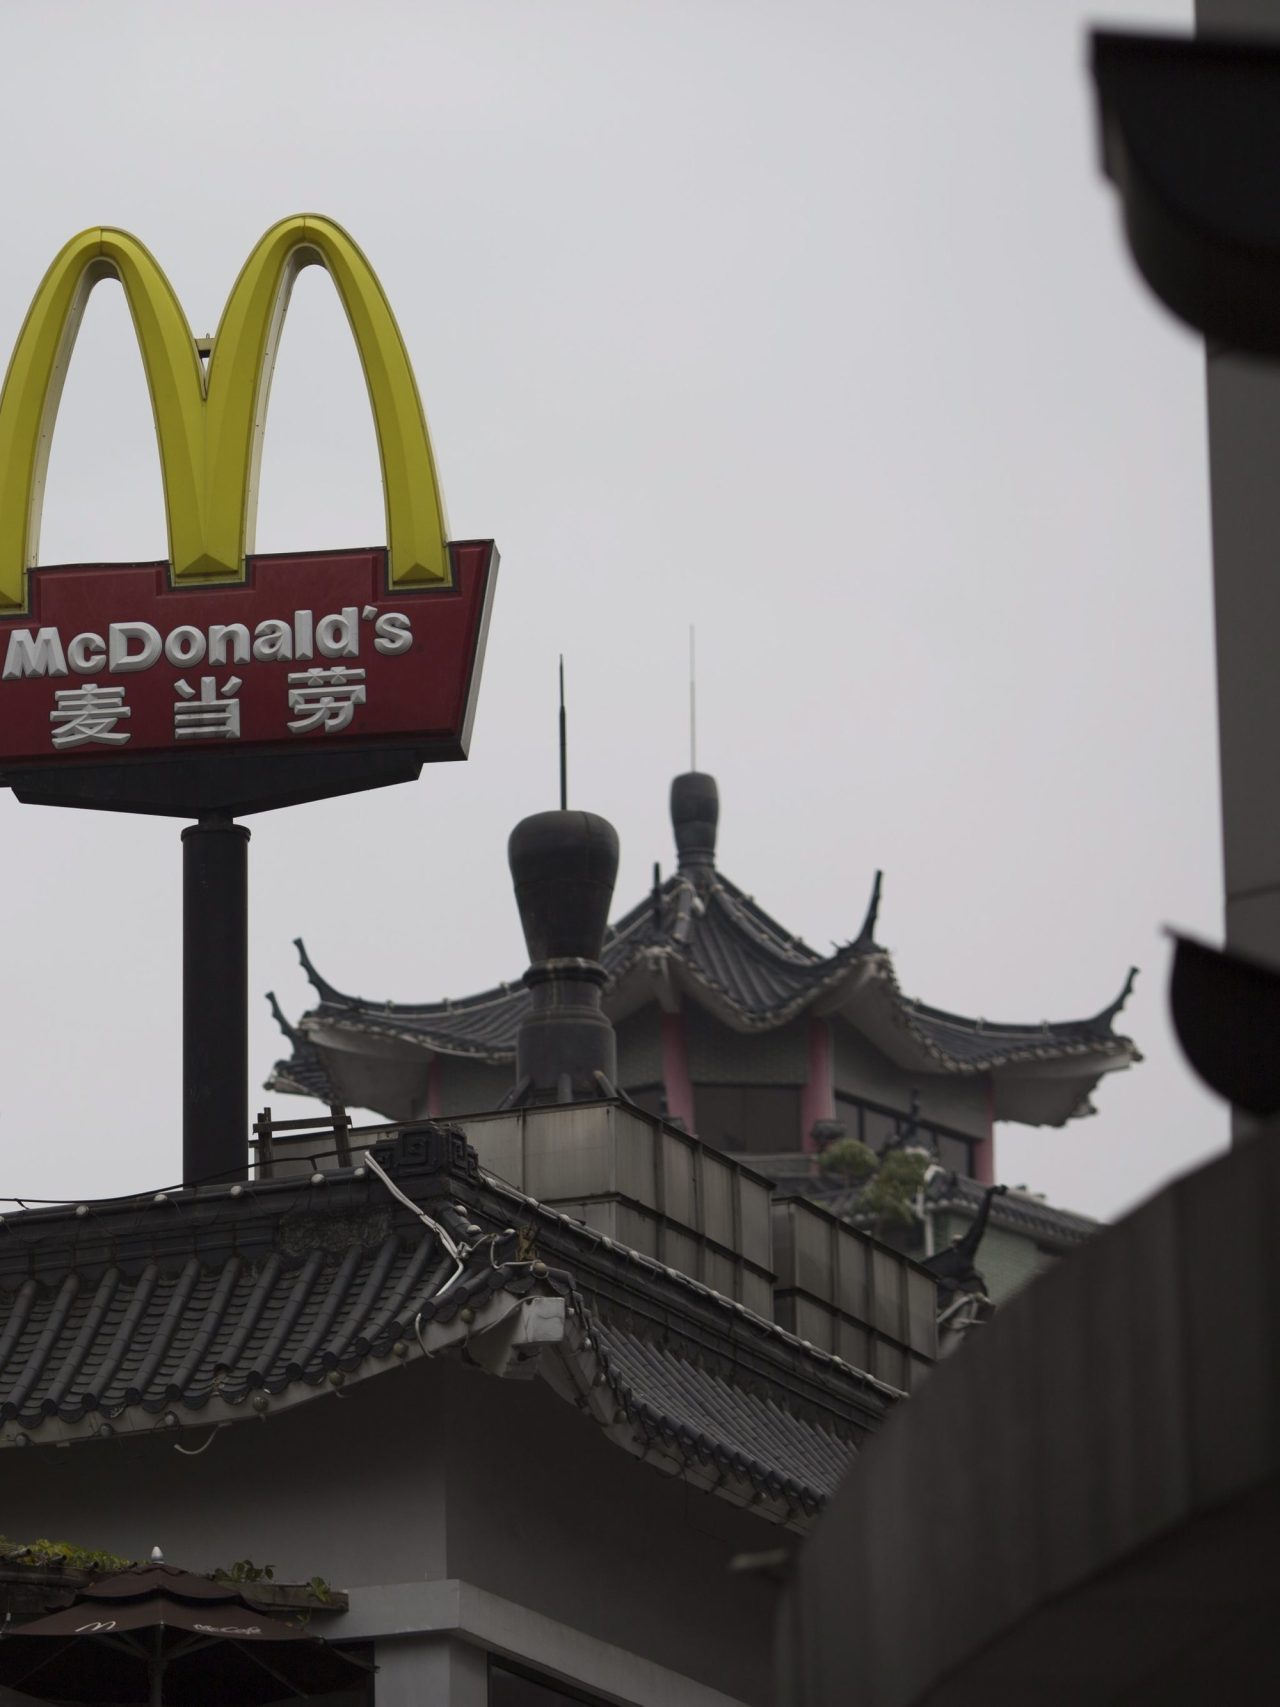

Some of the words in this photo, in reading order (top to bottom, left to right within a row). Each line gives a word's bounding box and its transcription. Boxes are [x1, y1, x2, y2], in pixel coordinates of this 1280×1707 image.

[1, 605, 413, 680] McDonald's
[49, 666, 367, 749] 麦当劳
